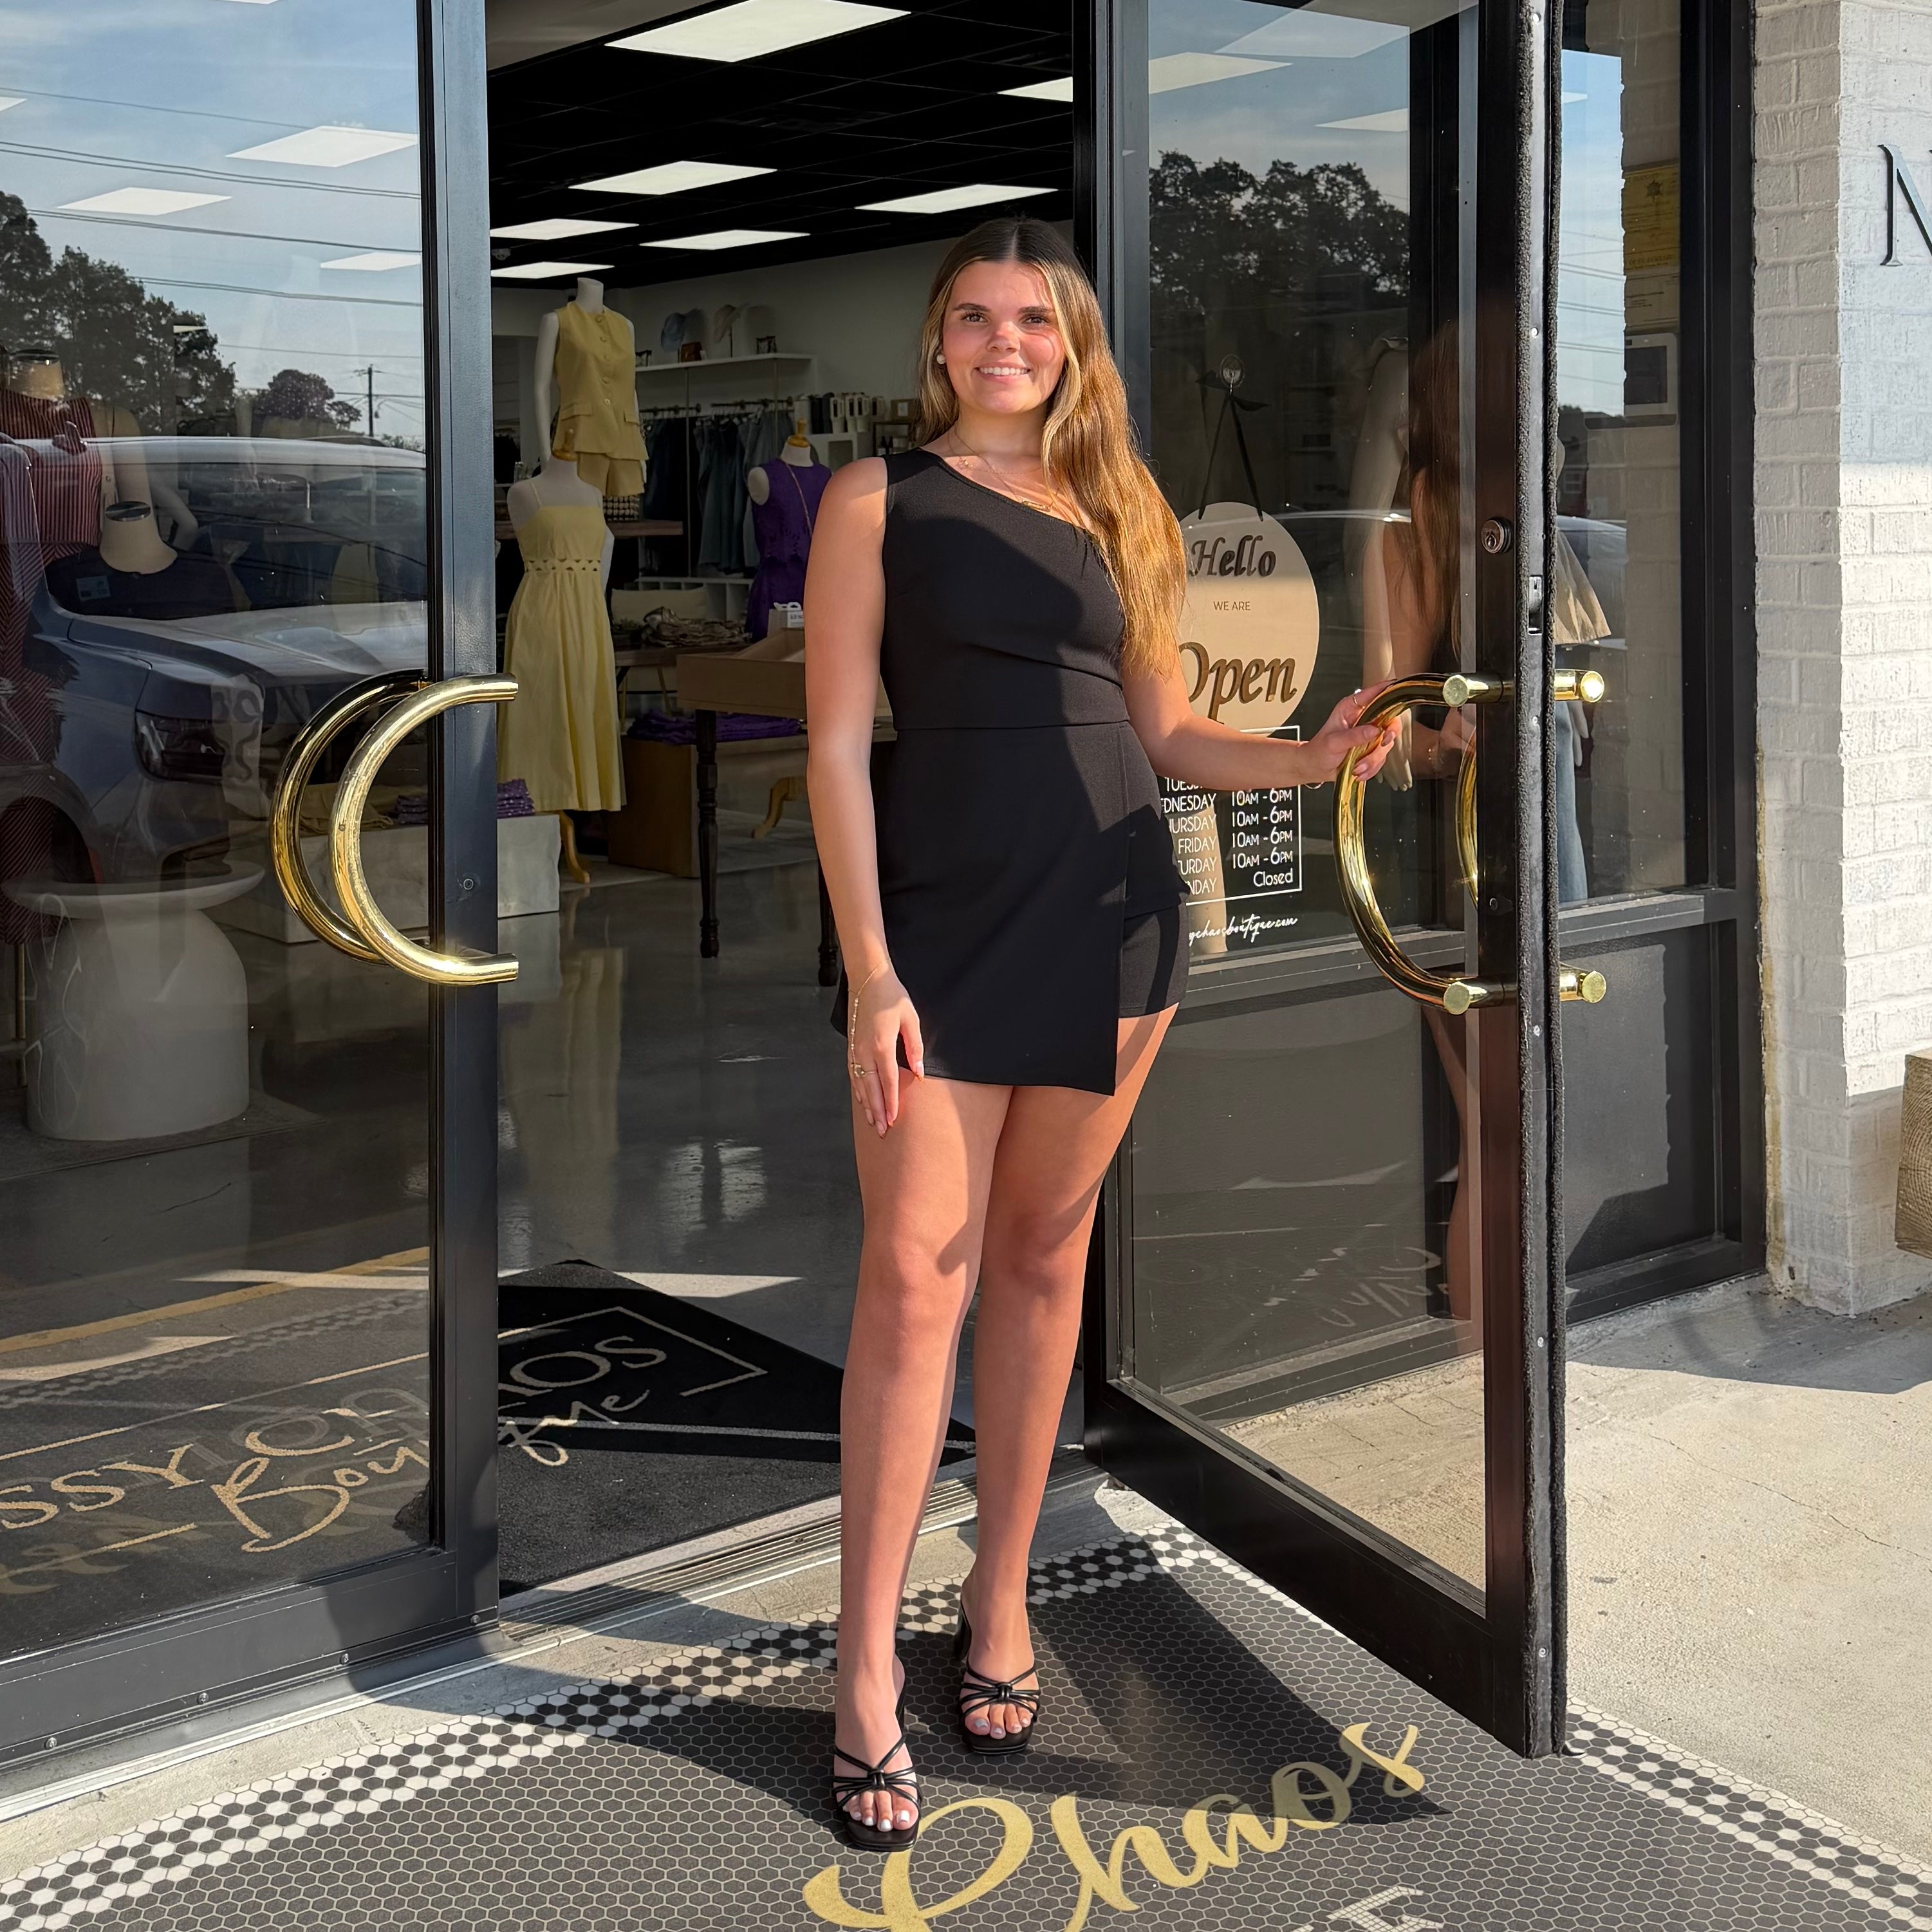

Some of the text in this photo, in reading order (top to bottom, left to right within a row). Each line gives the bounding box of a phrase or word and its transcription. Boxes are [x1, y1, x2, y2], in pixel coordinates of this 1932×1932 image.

[1189, 535, 1277, 577] Hello
[1213, 601, 1251, 611] WE ARE
[1160, 793, 1217, 813] DNESDAY
[1232, 790, 1259, 806] 10AM
[1270, 788, 1292, 804] 6PM
[1169, 814, 1217, 834] URSDAY
[1232, 811, 1259, 828] 10AM
[1270, 806, 1293, 824] 6PM
[1178, 836, 1217, 855] FRIDAY
[1232, 831, 1259, 848] 10AM
[1270, 826, 1293, 844] 6PM
[1178, 857, 1218, 875] URDAY
[1232, 853, 1260, 869] 10AM
[1270, 846, 1293, 865] 6PM
[1185, 868, 1294, 895] NDAY Closed
[1189, 913, 1298, 947] ychaosboutique.com
[0, 1444, 205, 1530] SSY
[802, 1723, 1426, 1932] Chaos
